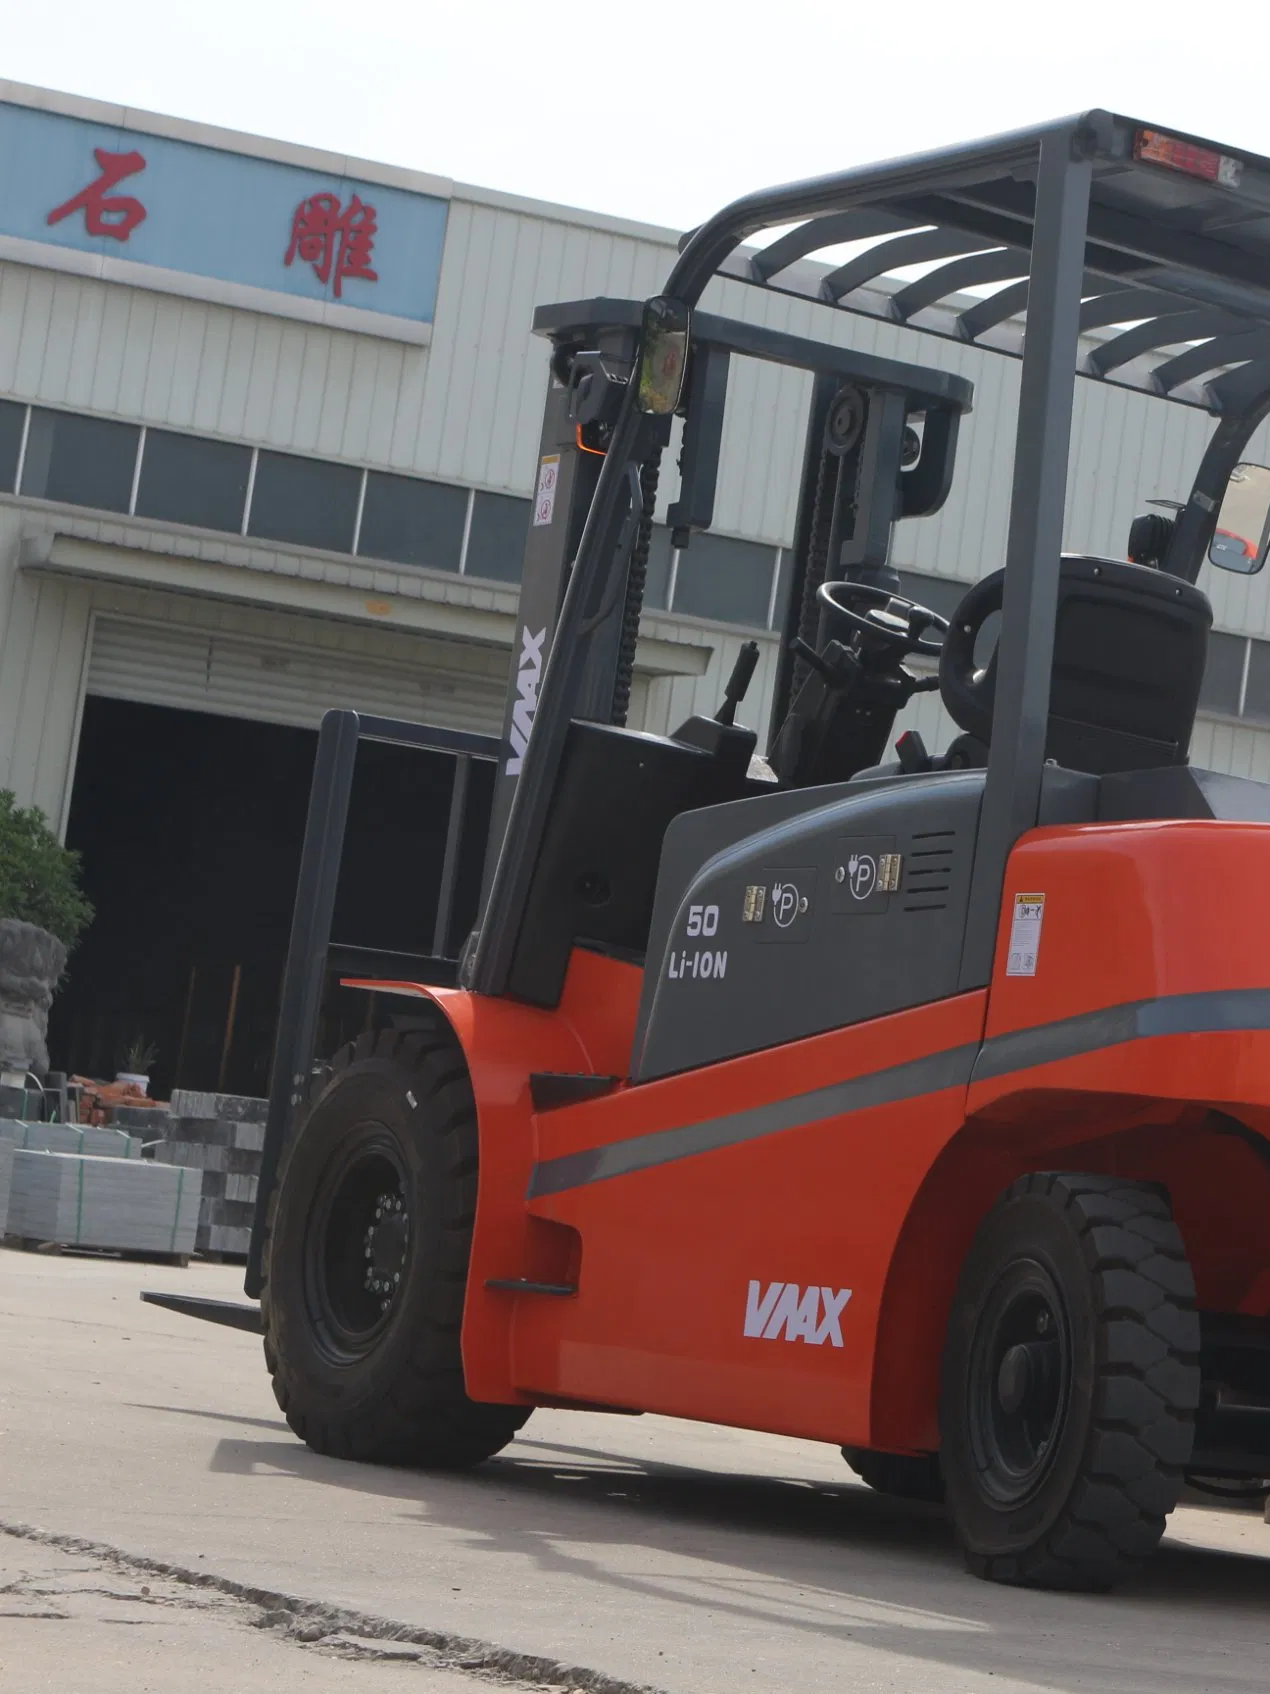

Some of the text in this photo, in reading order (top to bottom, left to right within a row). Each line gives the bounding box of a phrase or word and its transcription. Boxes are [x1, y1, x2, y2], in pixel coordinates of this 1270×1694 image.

[47, 148, 378, 298] 石雕
[505, 625, 547, 776] VMAX
[686, 905, 719, 936] 50
[743, 1280, 853, 1348] VMAX
